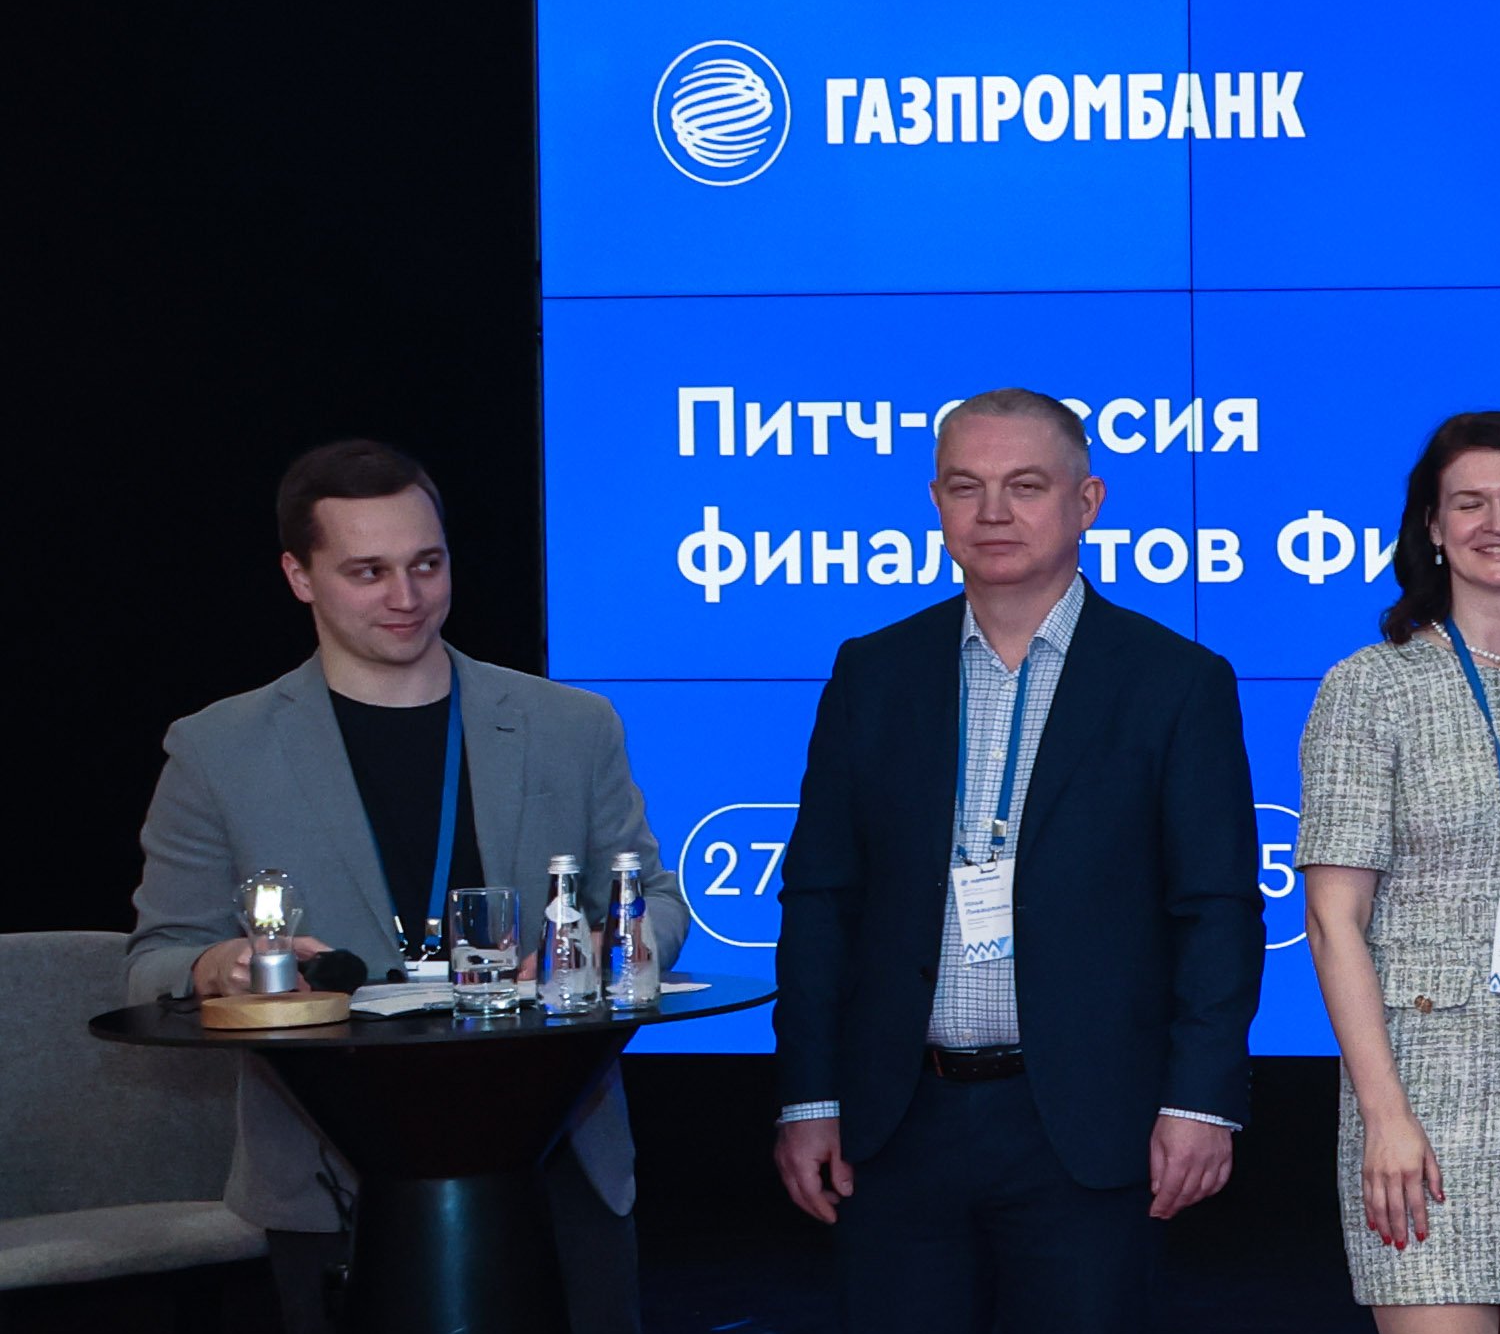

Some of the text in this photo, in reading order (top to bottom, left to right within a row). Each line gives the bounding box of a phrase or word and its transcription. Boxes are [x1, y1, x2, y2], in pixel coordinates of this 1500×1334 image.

[826, 71, 1305, 146] ГАЗПРОМБАНК
[677, 386, 1259, 457] Питч-сия
[676, 506, 1244, 604] финалтов
[703, 841, 786, 896] 27
